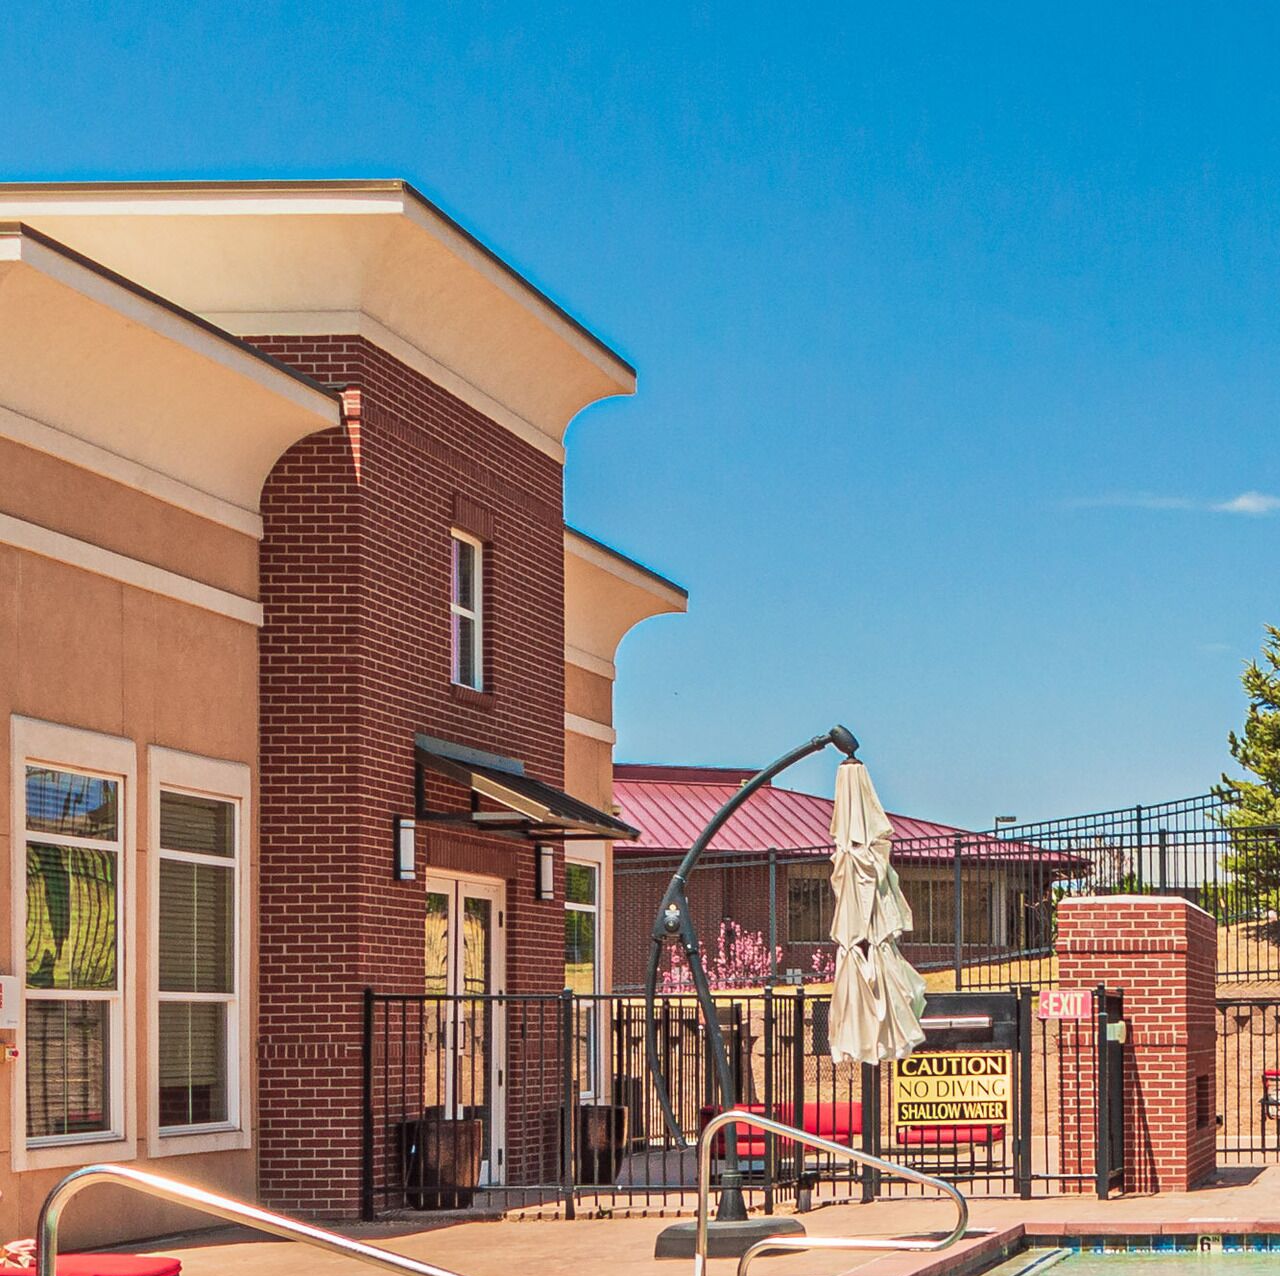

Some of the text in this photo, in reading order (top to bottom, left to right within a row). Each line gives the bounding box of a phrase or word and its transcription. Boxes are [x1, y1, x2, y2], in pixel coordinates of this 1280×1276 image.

[1049, 993, 1084, 1016] EXIT
[901, 1057, 1003, 1075] CAUTION
[899, 1079, 1005, 1098] NO DIVING
[901, 1103, 1004, 1120] SHALLOW WATER
[1200, 1236, 1211, 1252] 6
